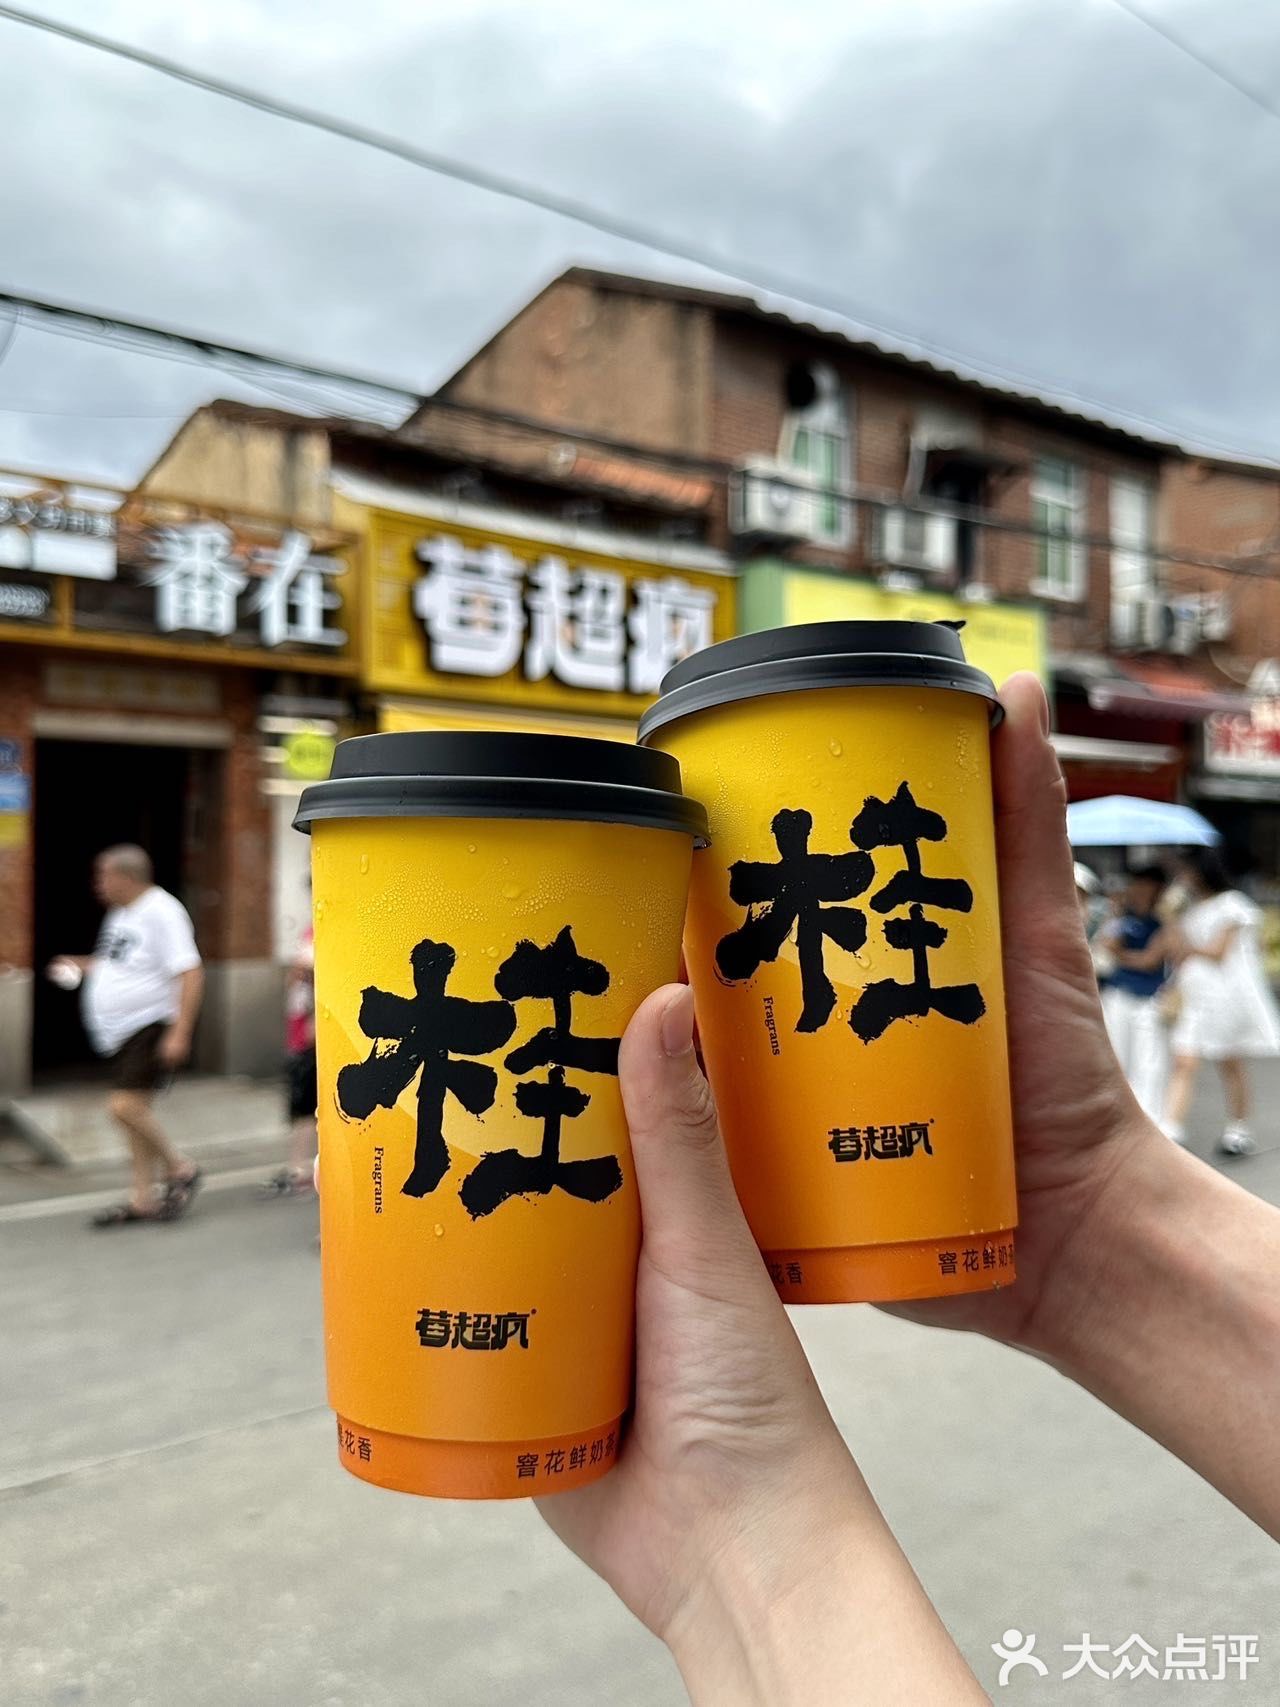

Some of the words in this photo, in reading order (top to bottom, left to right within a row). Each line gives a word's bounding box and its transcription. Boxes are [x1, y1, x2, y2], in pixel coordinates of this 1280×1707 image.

[713, 781, 987, 1046] 桂
[763, 996, 781, 1056] Fragrans
[333, 925, 624, 1221] 桂
[827, 1122, 933, 1162] 莓超疯
[374, 1146, 385, 1214] Fragrans
[415, 1308, 530, 1350] 莓超疯
